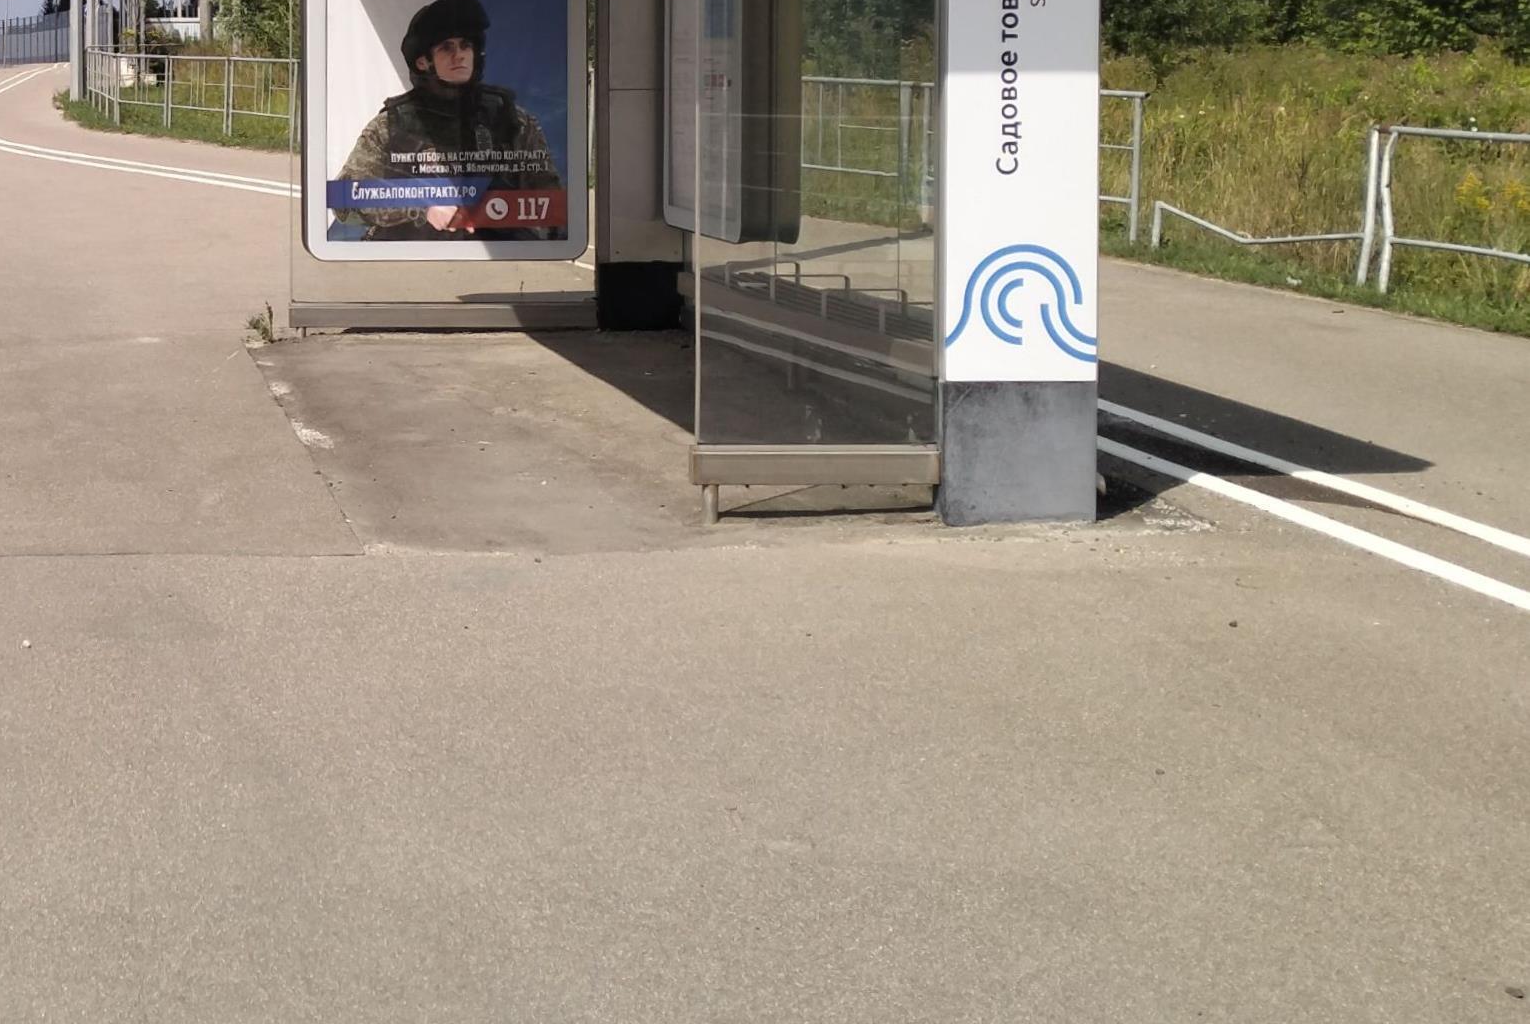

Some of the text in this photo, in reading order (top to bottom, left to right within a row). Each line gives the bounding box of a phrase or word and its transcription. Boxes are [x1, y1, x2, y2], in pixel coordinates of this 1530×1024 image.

[995, 50, 1022, 175] Садовое
[391, 152, 416, 163] ПУНКТ
[417, 151, 446, 163] ОТБОРА
[448, 151, 458, 162] НА
[459, 149, 490, 161] СЛУЖБУ
[491, 150, 502, 160] ПО
[517, 197, 550, 220] 117
